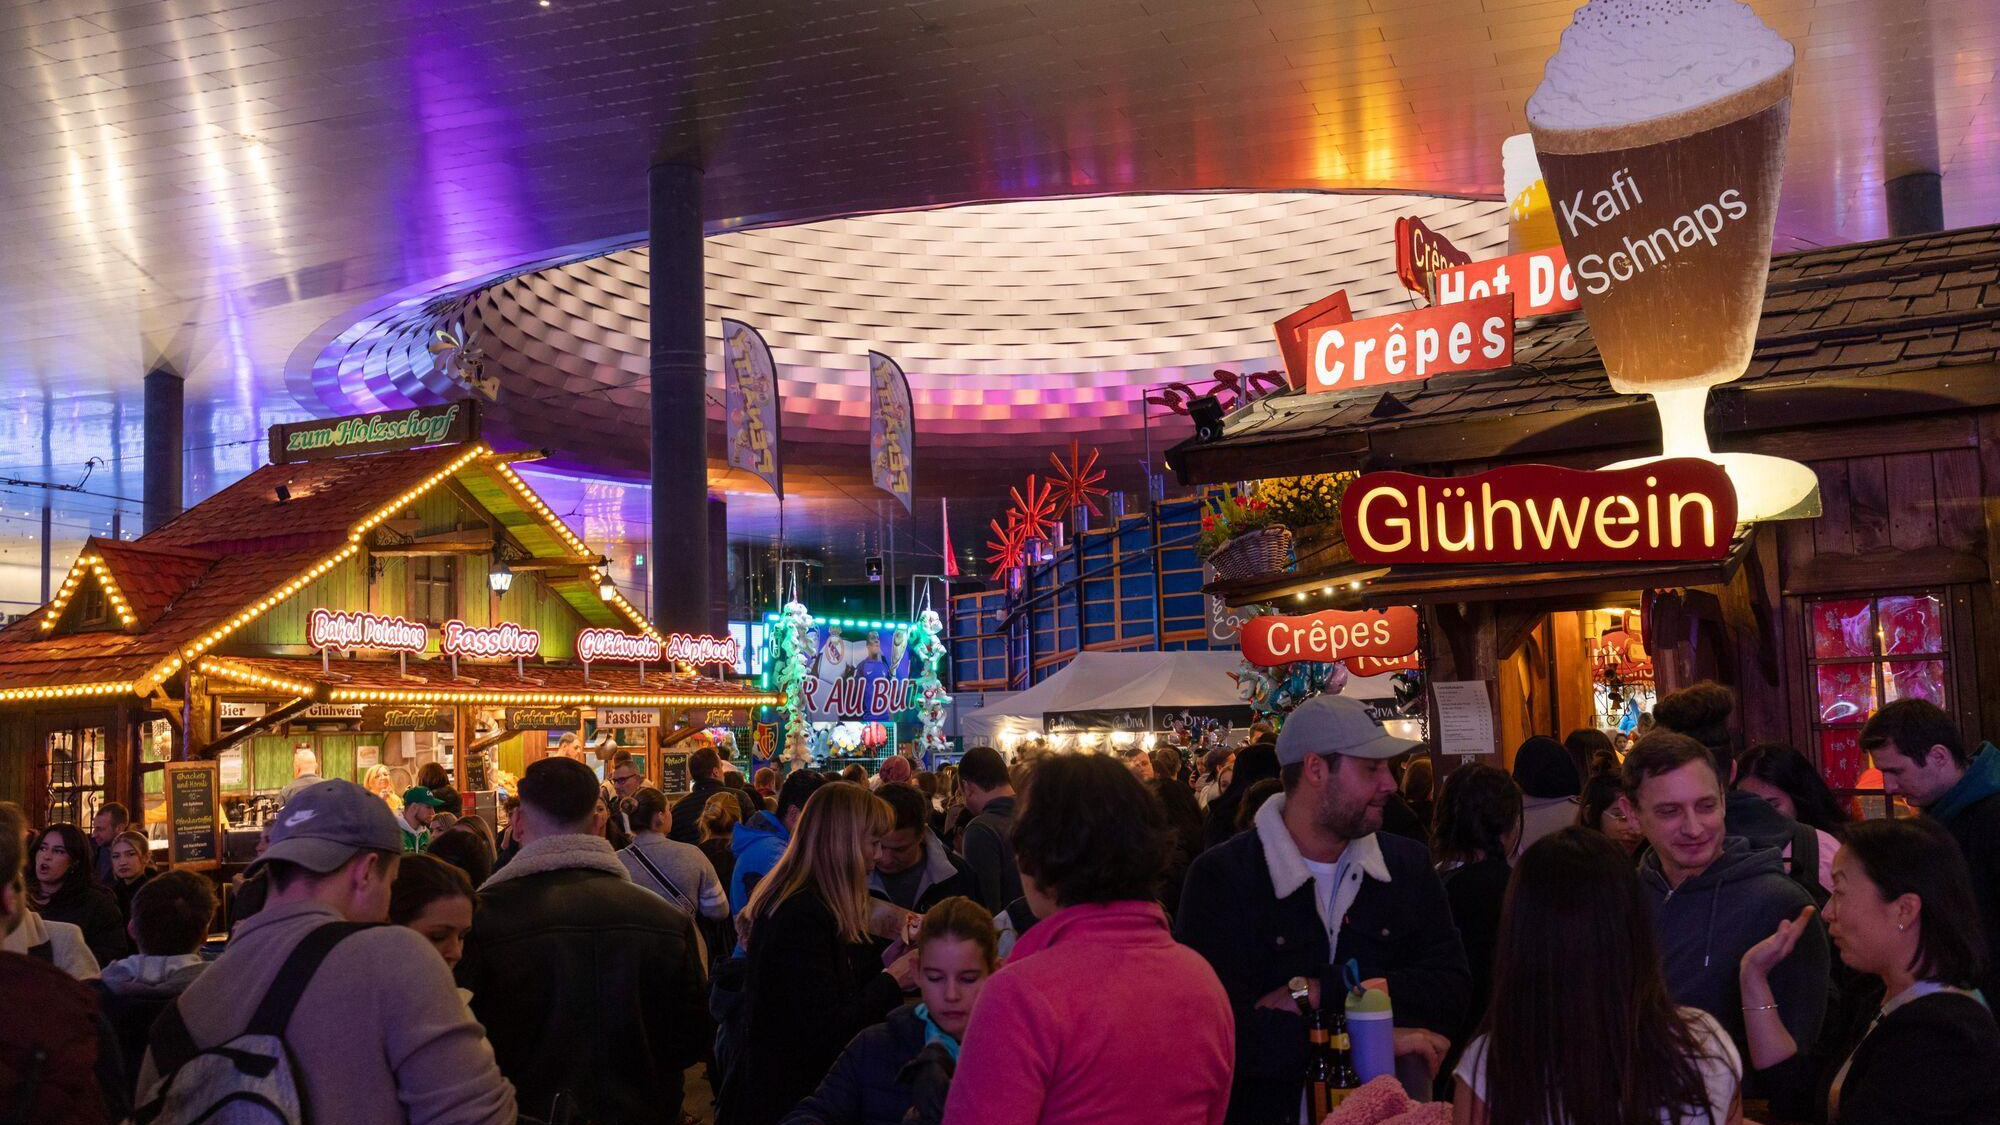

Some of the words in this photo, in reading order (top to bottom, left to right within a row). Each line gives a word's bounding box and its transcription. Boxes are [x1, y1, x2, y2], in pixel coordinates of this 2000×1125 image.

[1558, 167, 1643, 238] Kafi
[1577, 188, 1748, 295] Schnaps
[1440, 264, 1510, 306] Hot
[1529, 254, 1579, 308] Do
[1314, 316, 1506, 386] Crêpes
[286, 427, 333, 451] zum
[334, 404, 460, 446] Holzschopf
[1357, 476, 1715, 553] Glühwein
[314, 611, 362, 646] Baked
[364, 616, 425, 649] Potatoes
[447, 624, 539, 655] Fassbier
[580, 631, 660, 659] Glühwein
[668, 636, 737, 664] Alpfleck
[1267, 619, 1391, 659] Crêpes
[309, 704, 362, 716] Glühwein
[823, 676, 866, 717] AU
[604, 710, 653, 725] Fassbier
